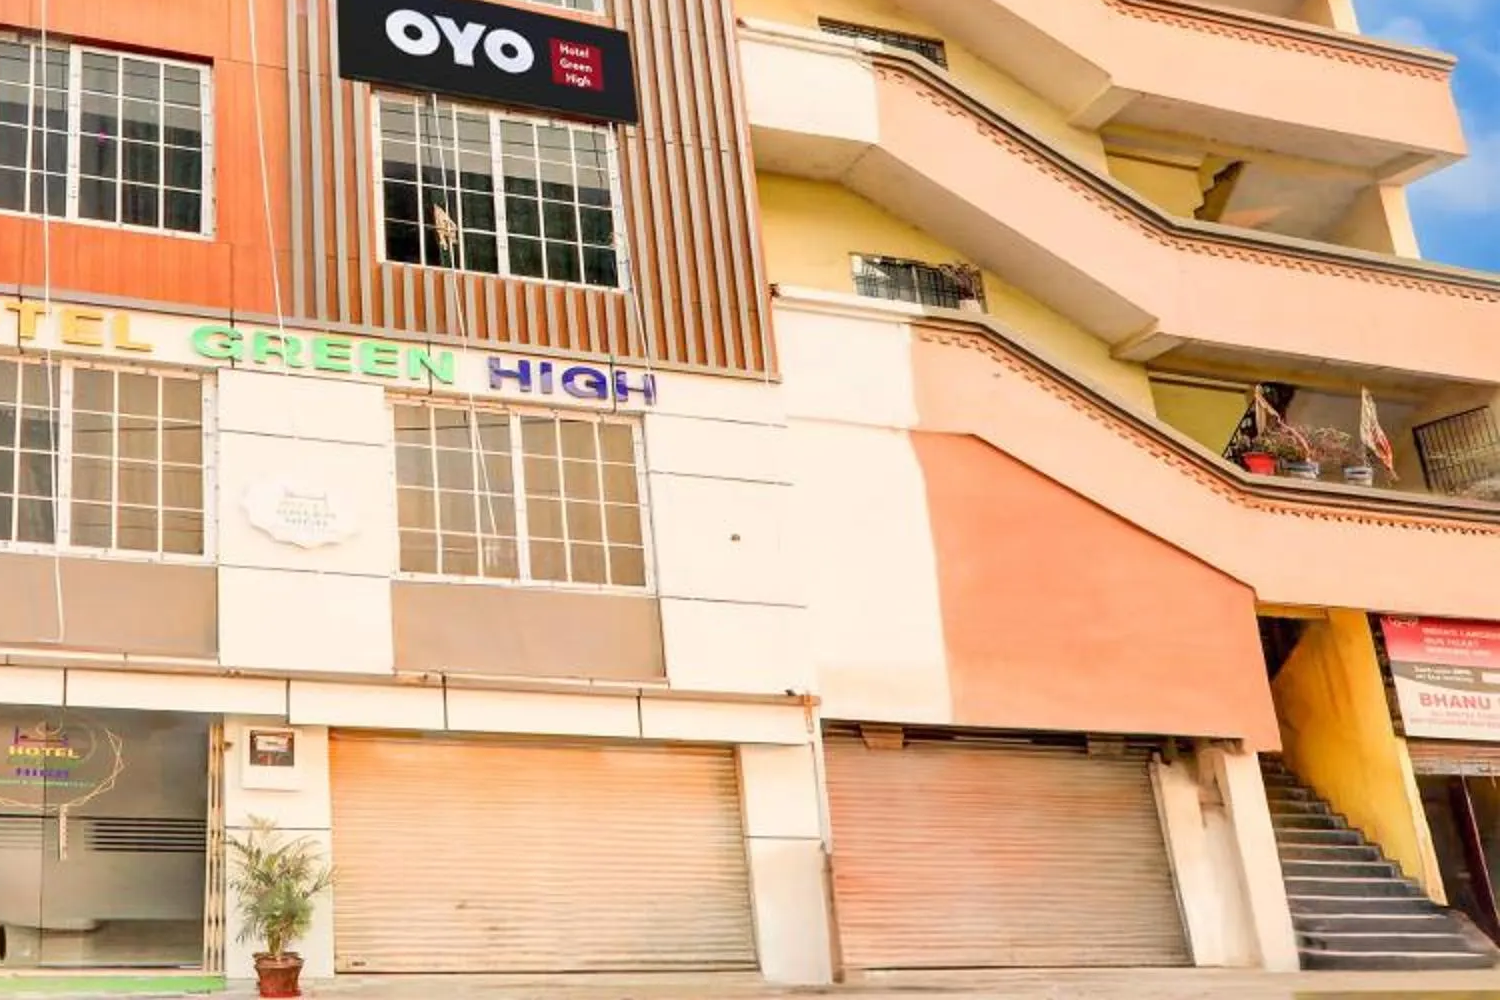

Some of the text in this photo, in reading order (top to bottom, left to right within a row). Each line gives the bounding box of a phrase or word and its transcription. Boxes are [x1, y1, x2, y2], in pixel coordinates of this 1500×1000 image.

[385, 9, 535, 74] OYO
[560, 42, 589, 58] Hotel
[560, 57, 593, 73] Green
[565, 72, 592, 87] High
[192, 324, 455, 385] GREEN
[487, 356, 657, 406] HIGH
[1418, 692, 1491, 711] BHANU
